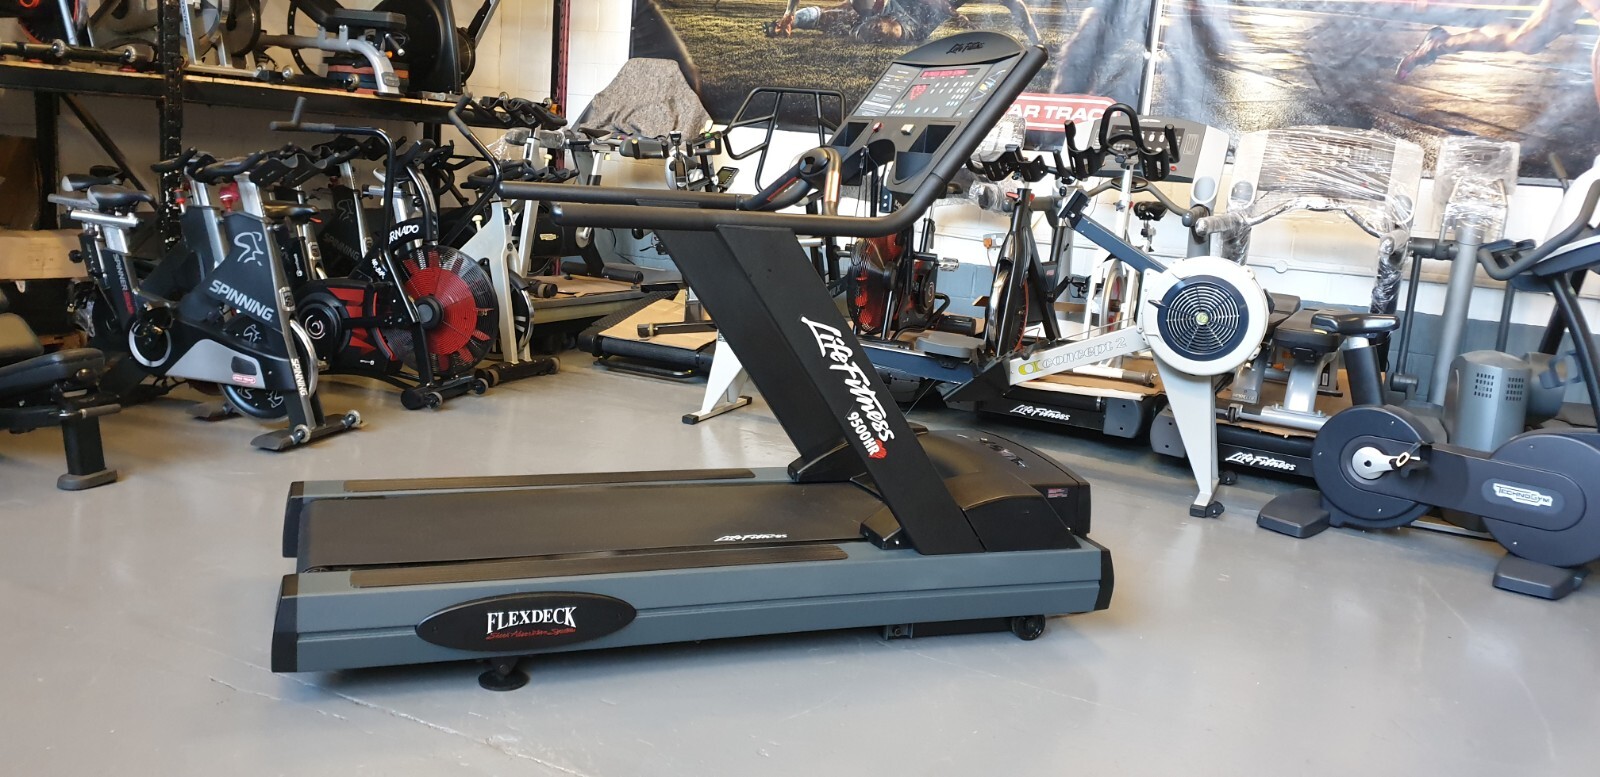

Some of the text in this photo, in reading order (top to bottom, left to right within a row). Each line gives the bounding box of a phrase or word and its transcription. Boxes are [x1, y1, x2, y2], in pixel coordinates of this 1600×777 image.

[1006, 103, 1040, 118] AR
[388, 224, 420, 245] RNADO
[112, 253, 128, 291] SPINNER
[208, 279, 275, 321] SPINNING
[1042, 337, 1128, 369] concept 2
[290, 358, 309, 396] SPINNING
[847, 411, 881, 456] 9500HR
[486, 606, 577, 634] FLEXDECK
